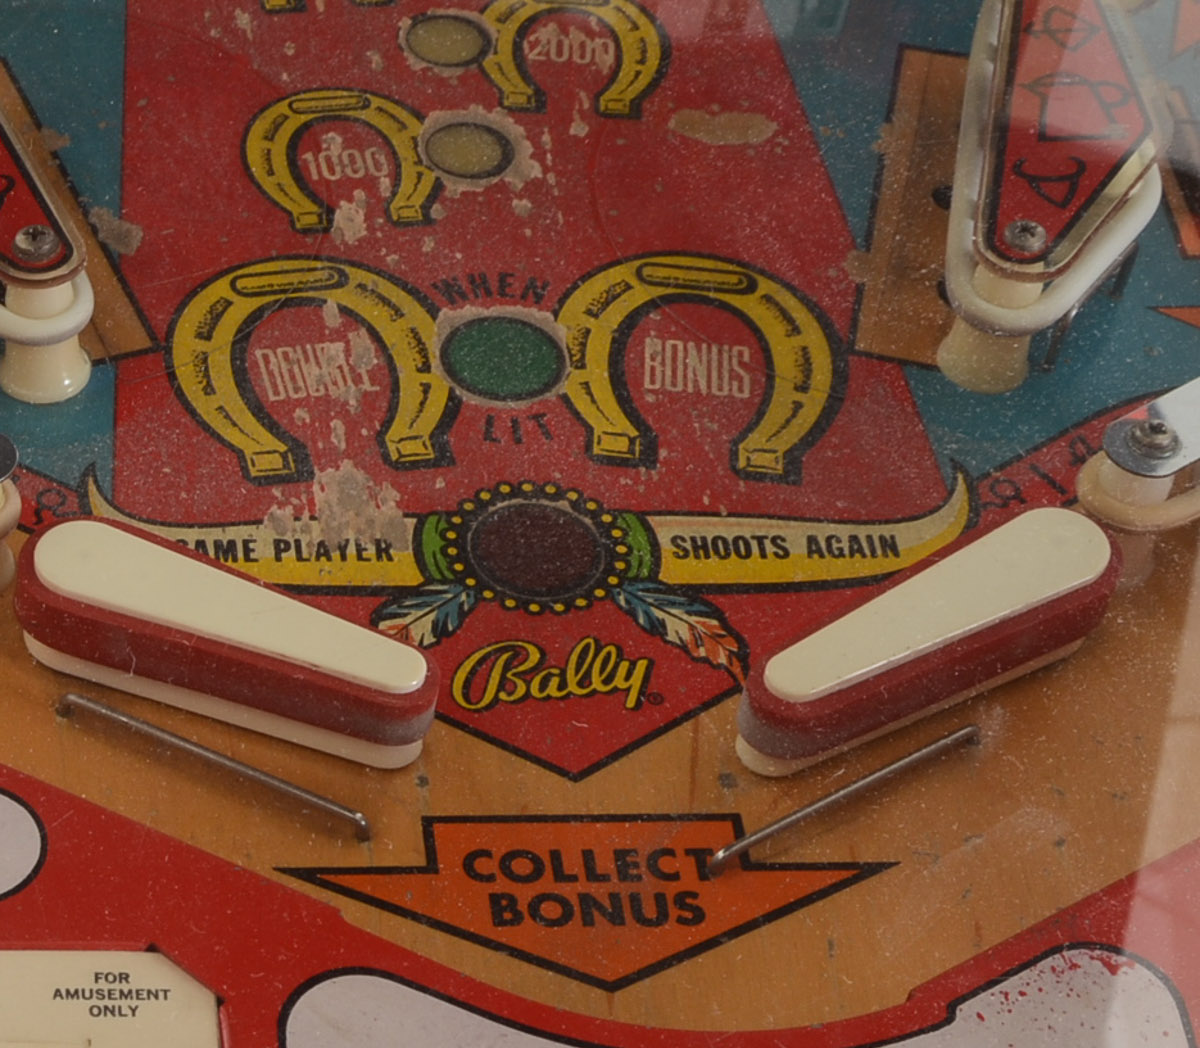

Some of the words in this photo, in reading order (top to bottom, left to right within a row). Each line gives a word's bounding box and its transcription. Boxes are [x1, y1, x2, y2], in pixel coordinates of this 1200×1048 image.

[527, 30, 616, 66] 2000
[301, 146, 390, 182] 1000
[430, 271, 551, 306] WHEN
[643, 336, 752, 399] BONUS
[483, 412, 554, 445] LIT
[272, 537, 395, 563] PLAYER
[670, 534, 791, 561] SHOOTS
[806, 533, 901, 559] AGAIN
[451, 636, 655, 712] Bally
[462, 848, 716, 884] COLLECT
[488, 891, 707, 928] BONUS
[52, 988, 171, 1001] AMUSEMENT
[93, 972, 131, 985] FOR
[88, 1005, 140, 1018] ONLY
